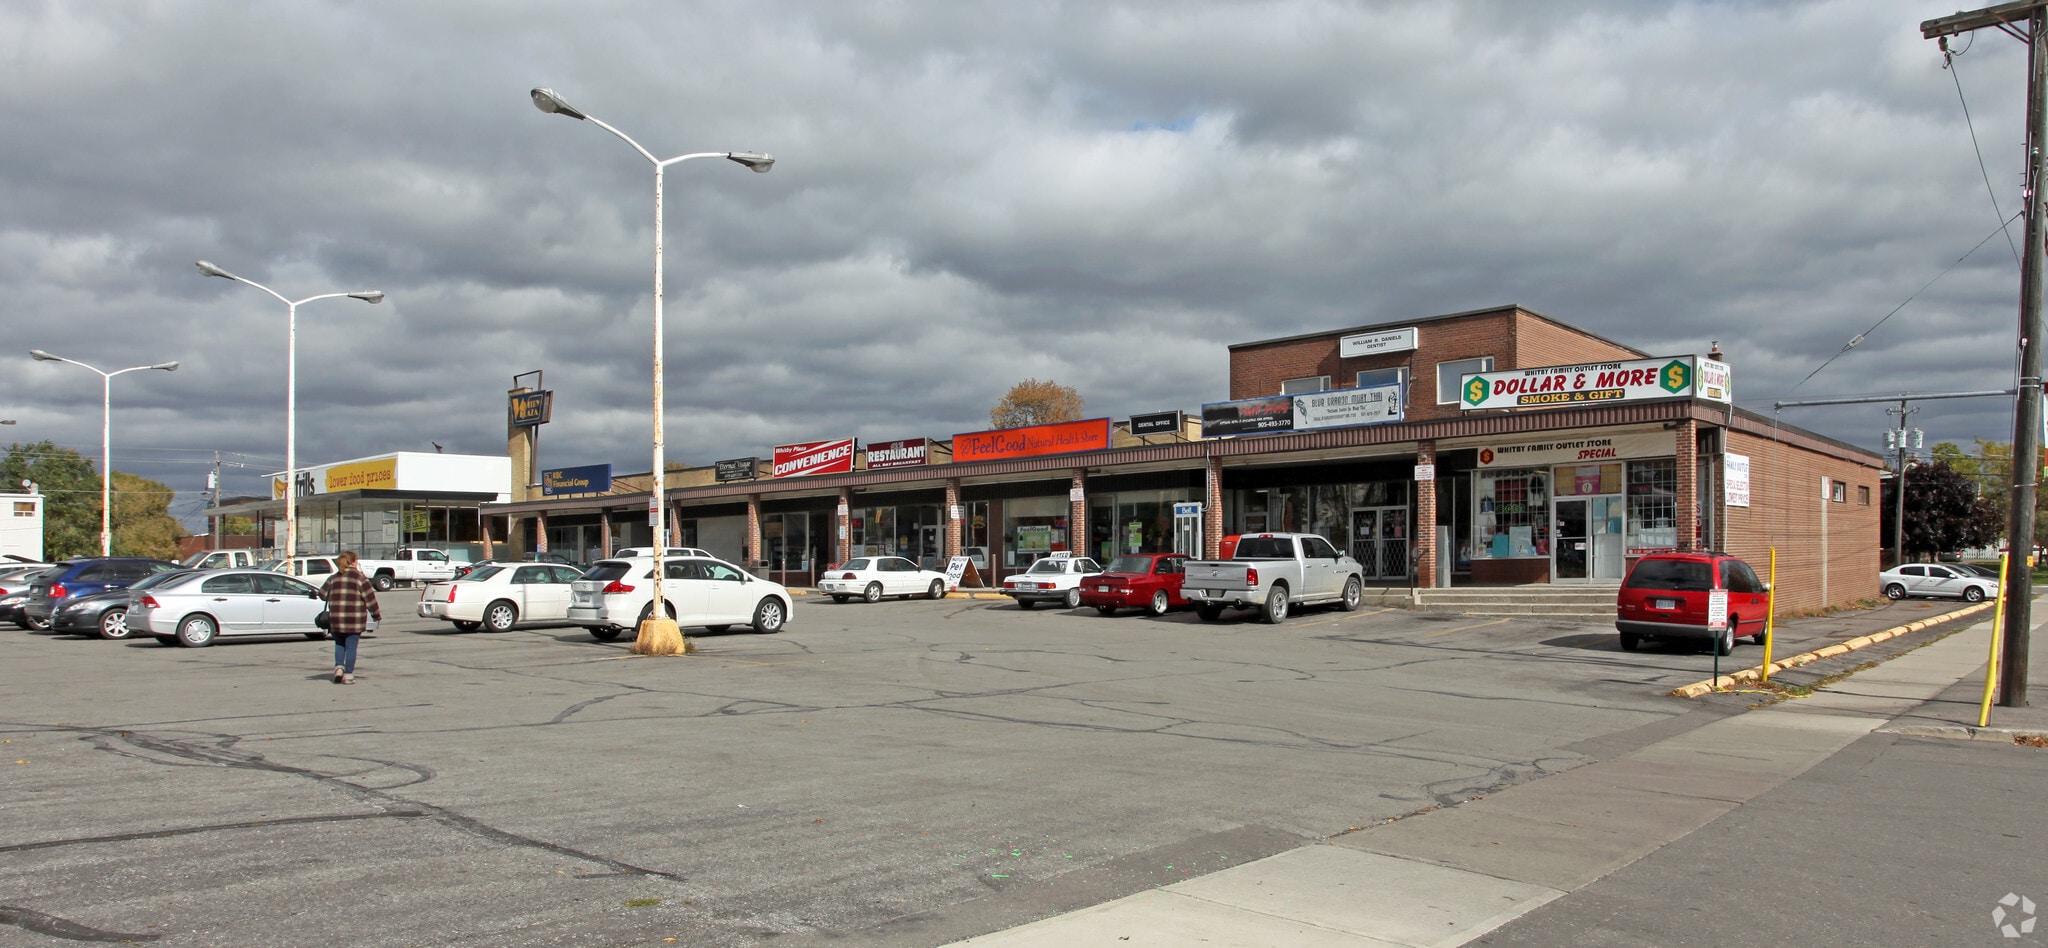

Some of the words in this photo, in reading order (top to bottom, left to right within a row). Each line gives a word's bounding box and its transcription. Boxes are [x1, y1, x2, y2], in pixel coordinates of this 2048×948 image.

[1524, 368, 1549, 376] WHITBY
[1574, 364, 1600, 373] OUTLET
[1492, 374, 1567, 396] DOLLAR
[1572, 373, 1586, 389] &
[1595, 367, 1658, 388] MORE
[1369, 391, 1383, 402] THAI
[1520, 393, 1571, 404] SMOKE
[1573, 392, 1585, 401] &
[1588, 389, 1624, 399] GIFT
[1257, 419, 1291, 429] 905-493-3770
[775, 446, 793, 454] Whitby
[793, 445, 807, 453] Plaza
[971, 434, 1027, 455] FeelGood
[1027, 436, 1055, 450] Natural
[1056, 434, 1080, 446] Health
[1081, 431, 1099, 443] Store
[1497, 445, 1526, 454] WHITBY
[1527, 444, 1554, 452] FAMILY
[1555, 441, 1585, 450] OUTLET
[1586, 438, 1612, 448] STORE
[774, 443, 852, 476] CONVENIENCE
[868, 445, 926, 463] RESTAURANT
[1577, 447, 1617, 460] SPECIAL
[295, 471, 316, 498] frills
[329, 475, 348, 489] lower
[349, 471, 365, 486] food
[366, 469, 391, 486] prices
[553, 478, 574, 488] Financial
[574, 478, 590, 488] Group
[950, 562, 963, 571] Pet
